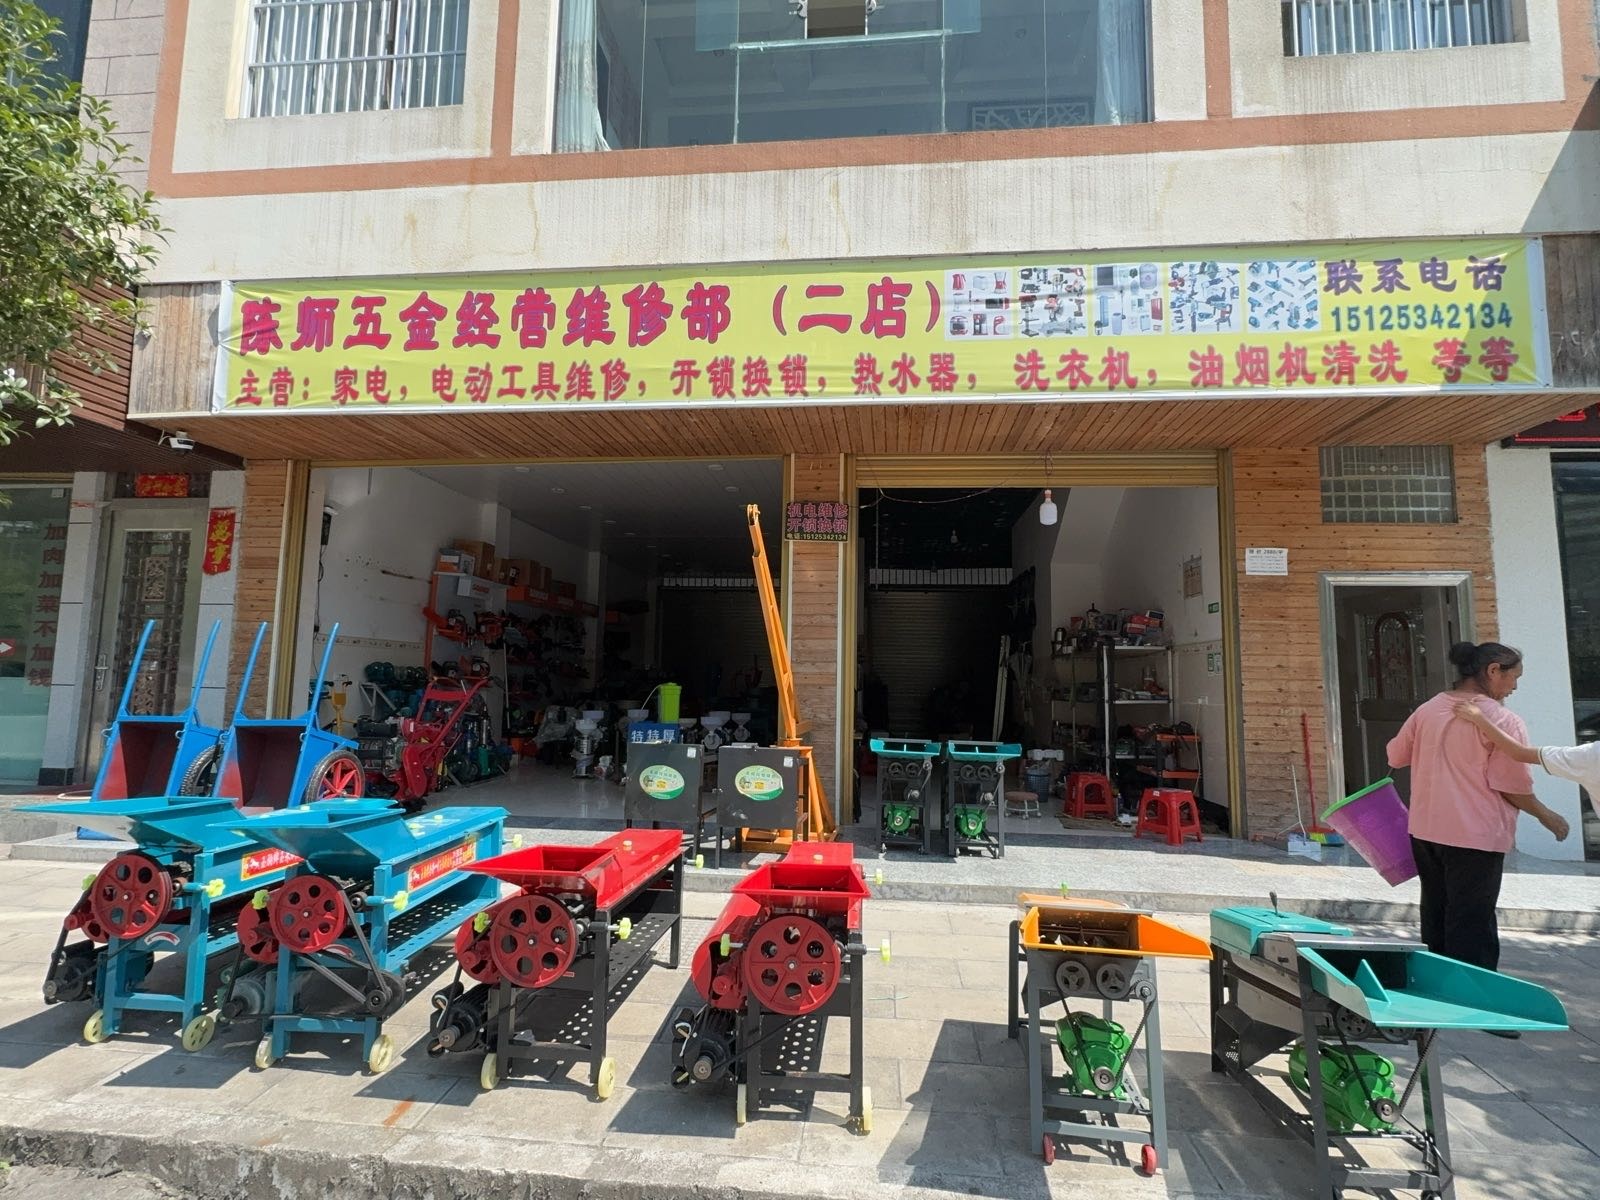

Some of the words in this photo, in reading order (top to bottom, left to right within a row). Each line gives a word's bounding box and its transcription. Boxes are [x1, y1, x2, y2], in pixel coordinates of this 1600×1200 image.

[1323, 255, 1508, 296] 联系电话
[240, 276, 941, 355] 陈师五金经营维修部（二店）
[1330, 300, 1514, 333] 15125342134
[787, 518, 847, 533] 开锁换锁
[788, 503, 848, 517] 机电维修
